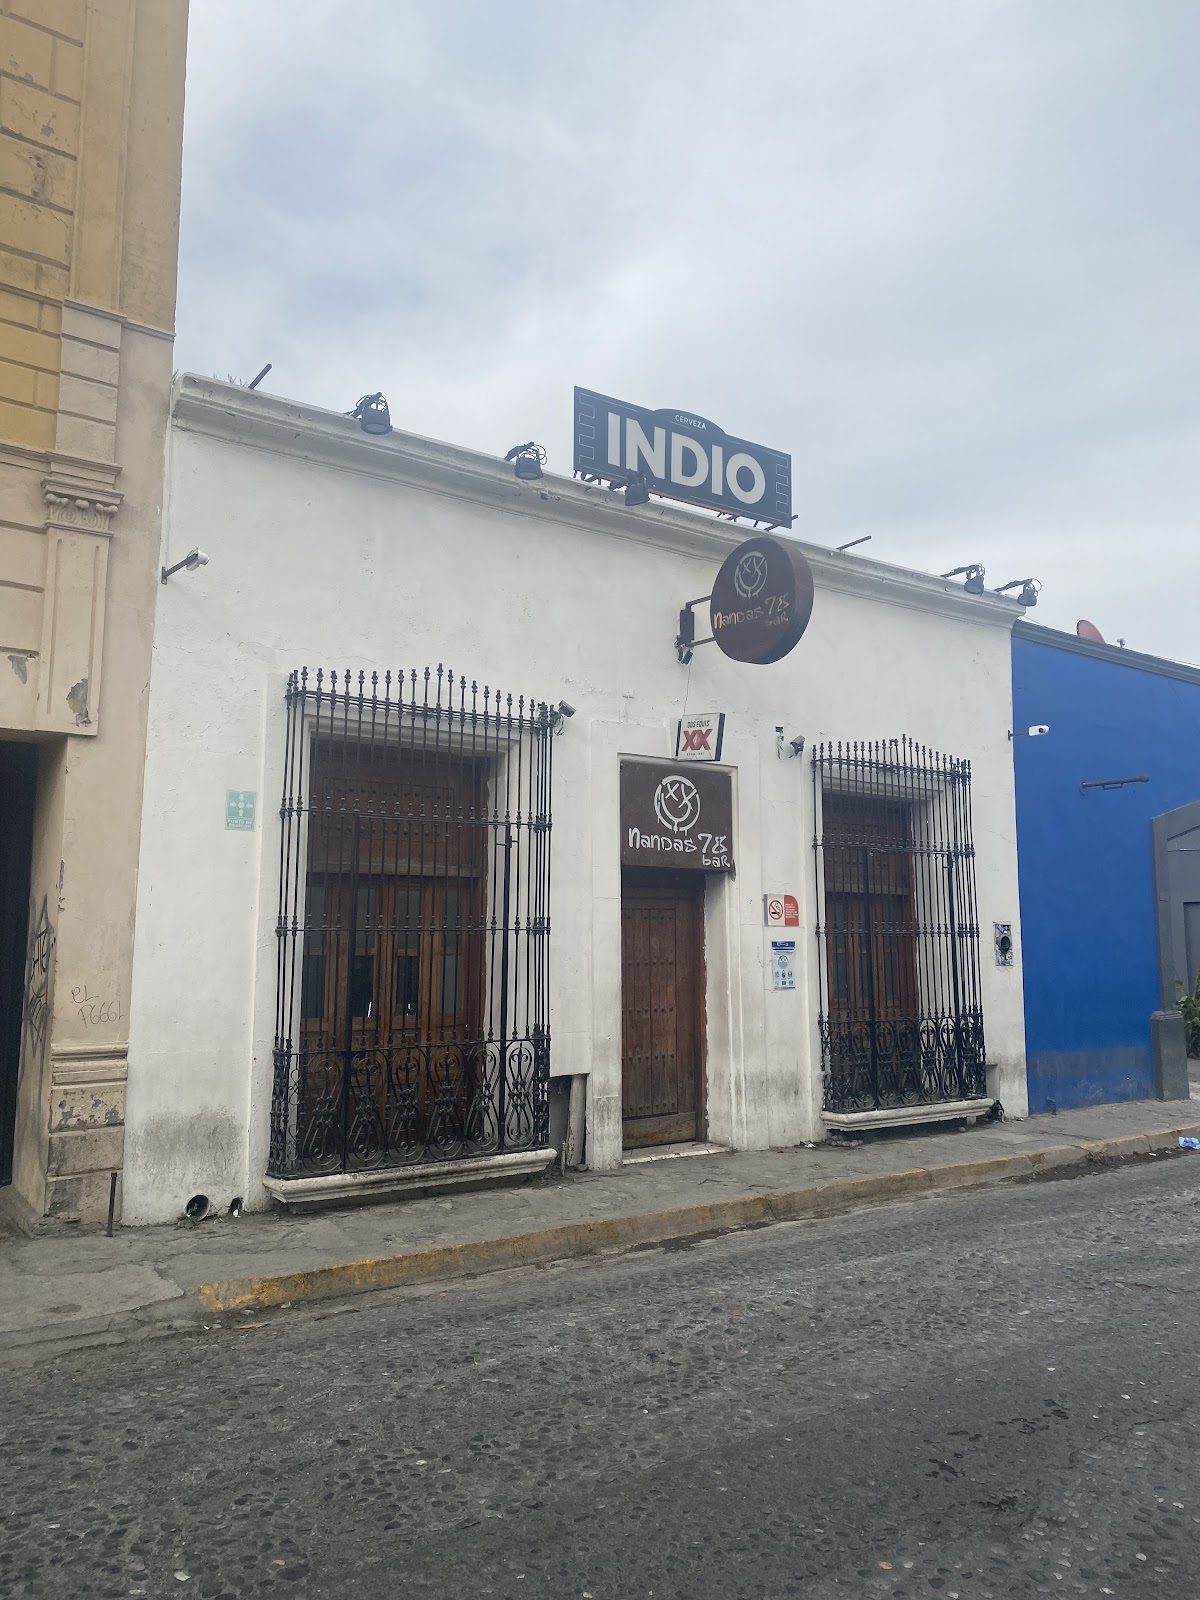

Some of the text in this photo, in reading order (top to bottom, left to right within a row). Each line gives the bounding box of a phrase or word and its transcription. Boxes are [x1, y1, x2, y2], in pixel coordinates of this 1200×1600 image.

[674, 414, 707, 430] CERVEZA
[607, 411, 766, 505] INDIO
[681, 728, 713, 752] XX
[697, 833, 728, 854] 78
